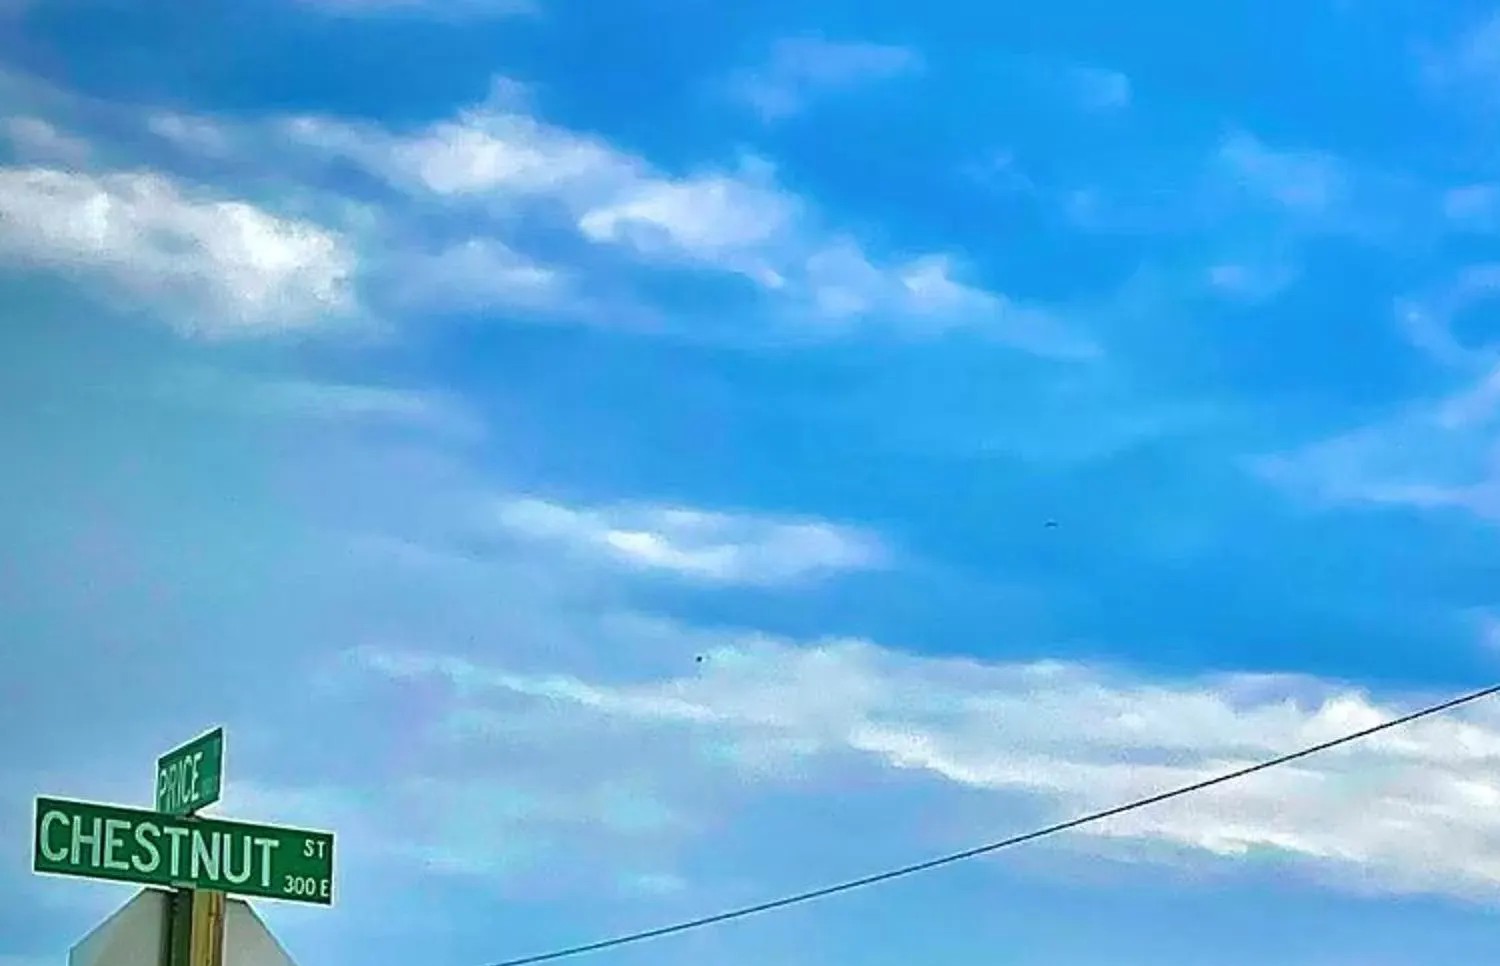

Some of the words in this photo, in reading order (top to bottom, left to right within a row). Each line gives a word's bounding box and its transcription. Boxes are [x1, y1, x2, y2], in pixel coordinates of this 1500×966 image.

[159, 752, 203, 813] PRICE
[40, 811, 279, 887] CHESTNUT
[304, 839, 326, 860] ST
[284, 875, 316, 896] 300
[320, 879, 329, 897] E
